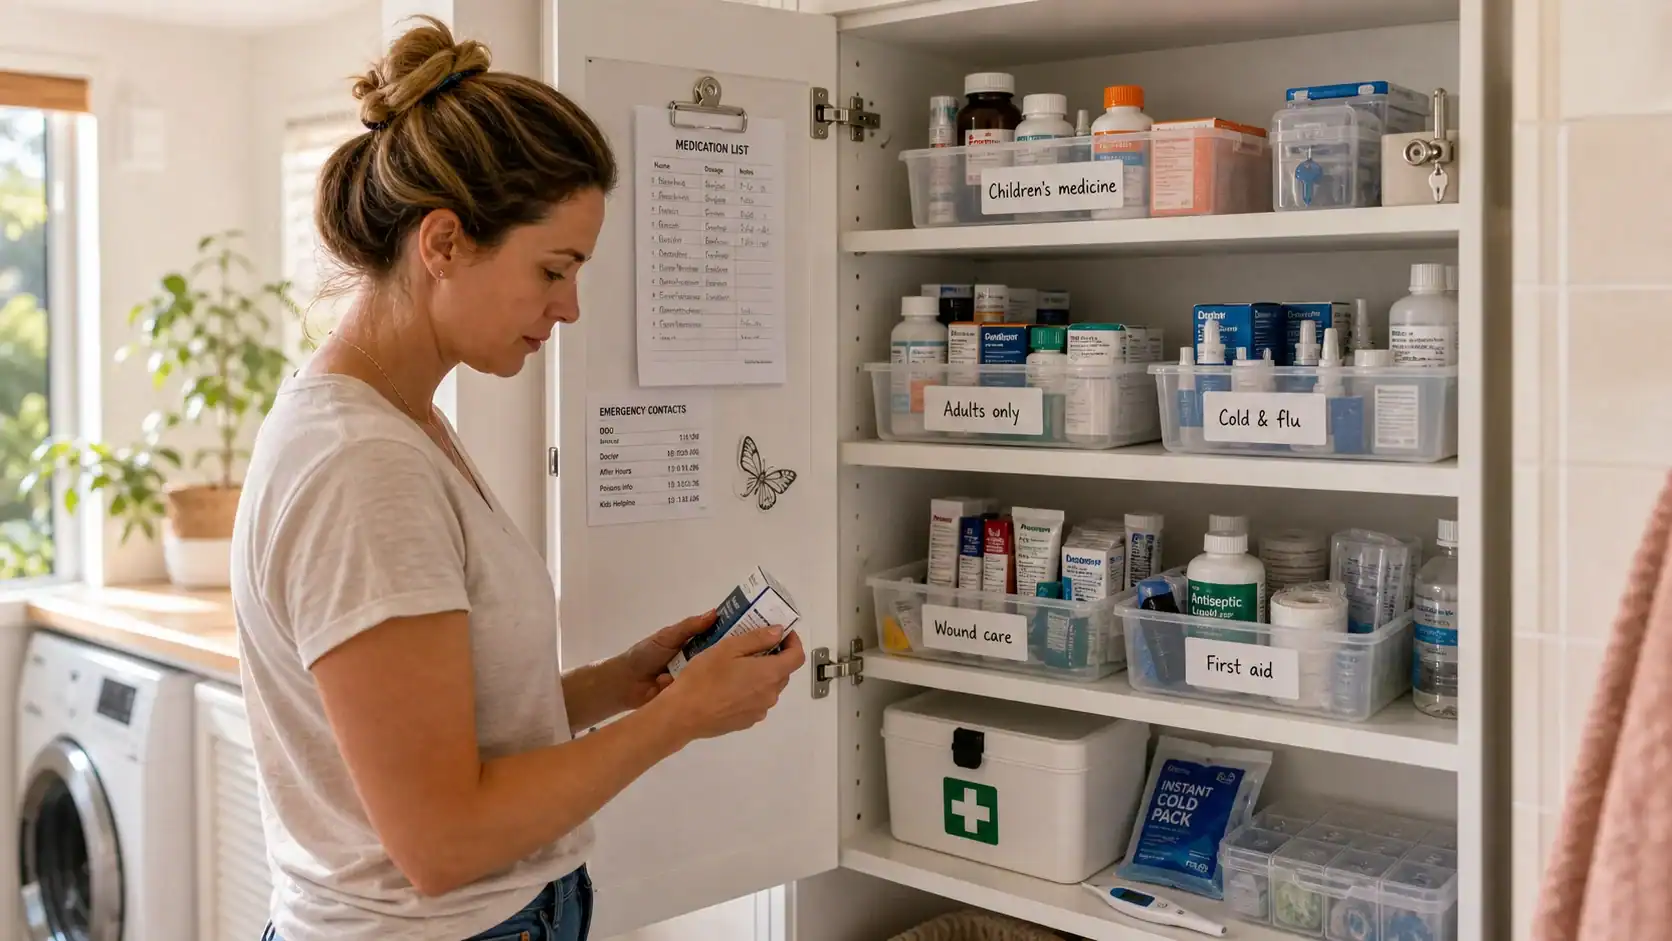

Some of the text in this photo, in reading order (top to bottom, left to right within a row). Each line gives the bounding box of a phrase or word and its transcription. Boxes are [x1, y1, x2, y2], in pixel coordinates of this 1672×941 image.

[675, 139, 750, 155] MEDICATION LIST
[654, 161, 671, 170] Name
[988, 178, 1117, 200] Children's medicine
[600, 404, 687, 417] EMERGENCY CONTACTS
[943, 400, 1020, 426] Adults only
[1218, 408, 1302, 428] Cold & flu
[1191, 592, 1243, 611] Antiseptic
[934, 619, 1013, 645] Wound care
[1206, 654, 1274, 680] First aid
[1160, 780, 1214, 798] INSTANT
[1157, 793, 1199, 811] COLD
[1151, 807, 1193, 827] PACK
